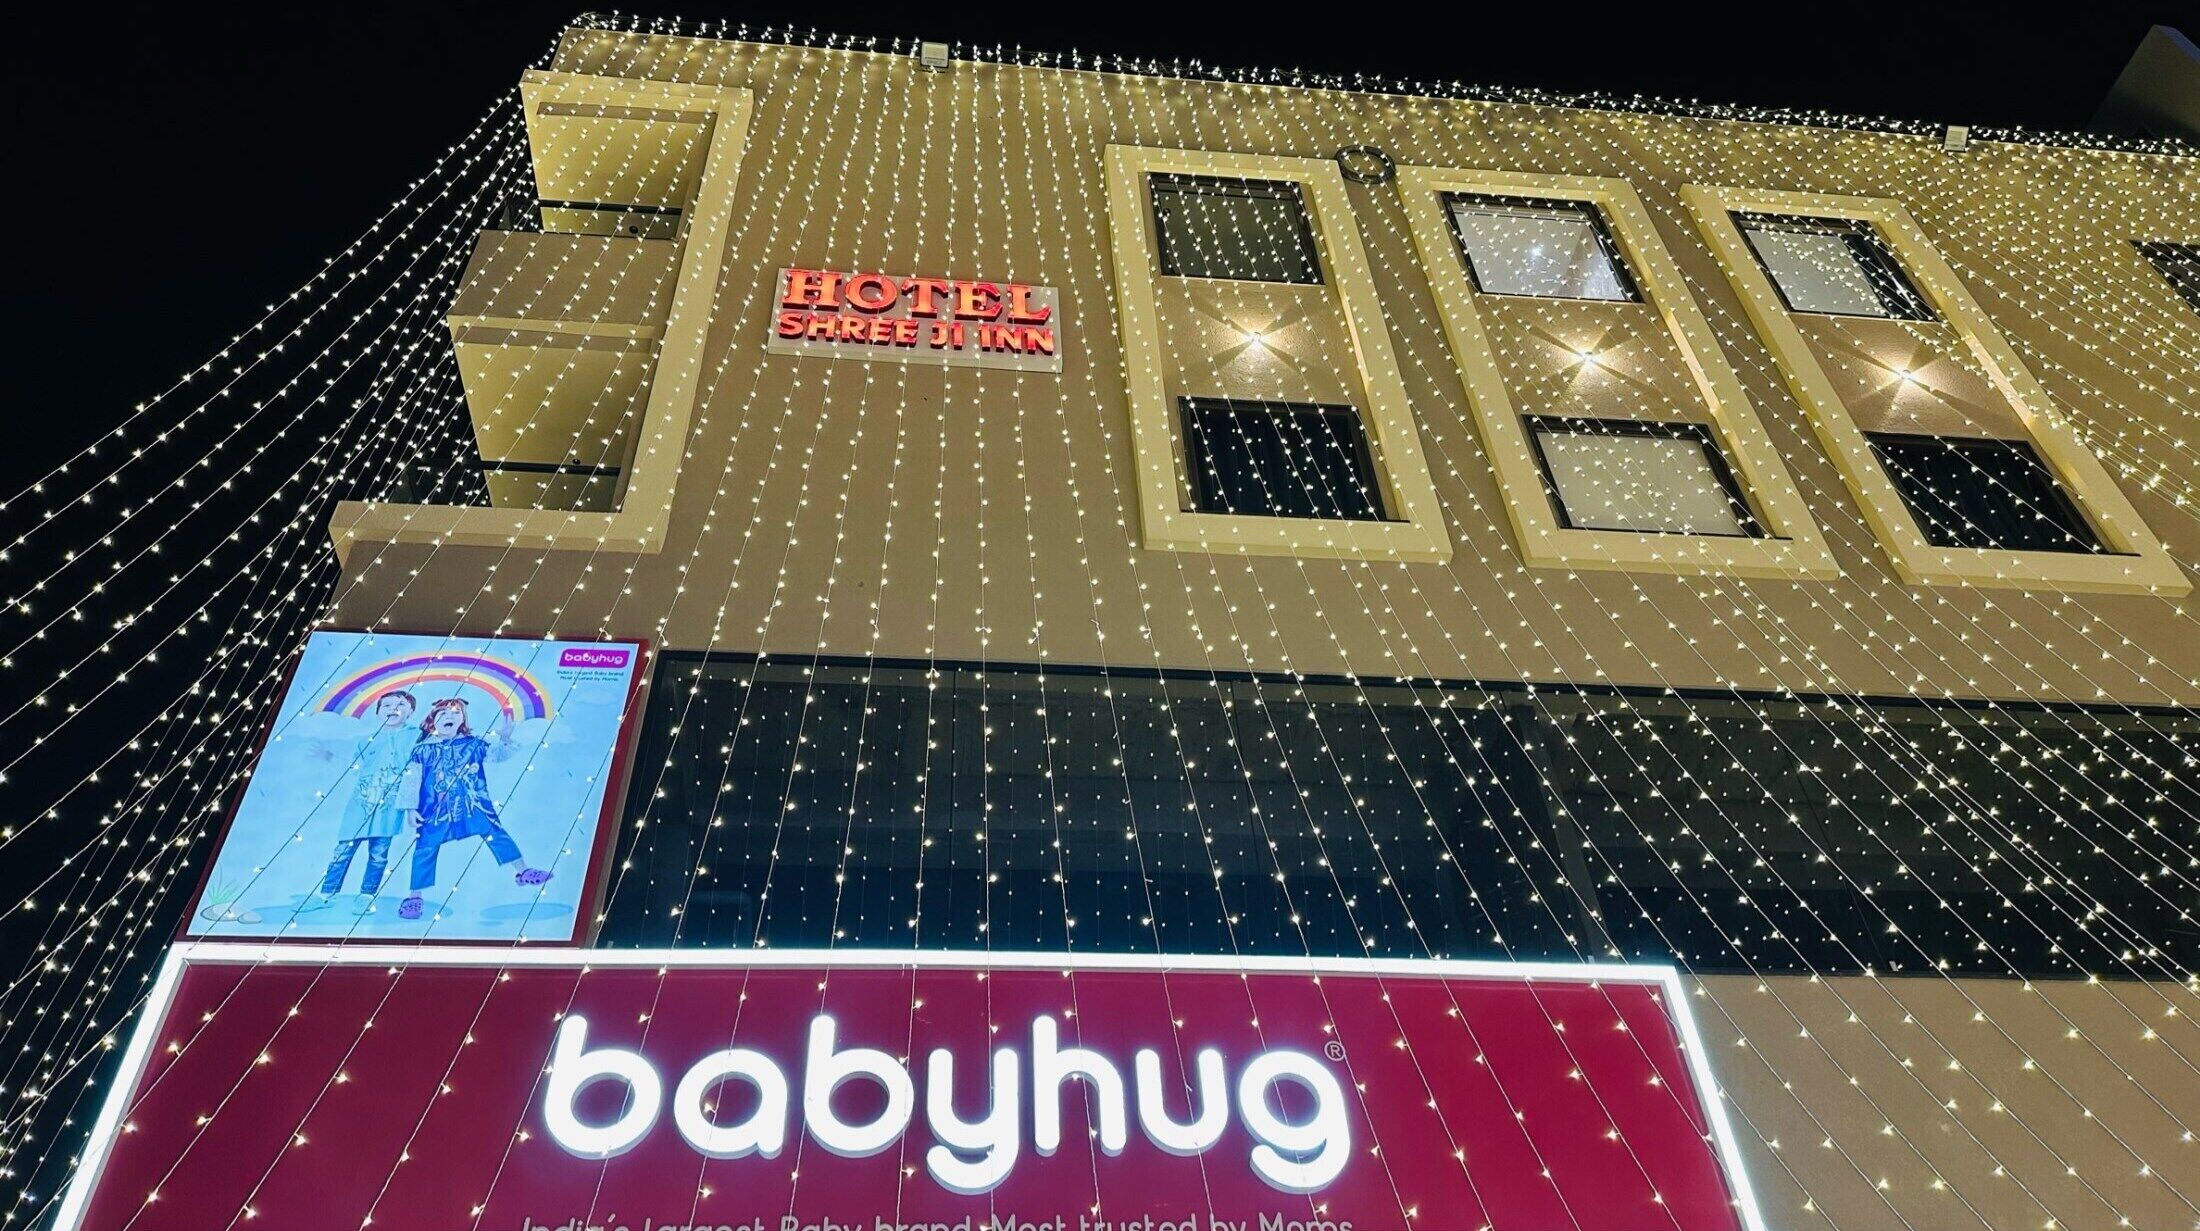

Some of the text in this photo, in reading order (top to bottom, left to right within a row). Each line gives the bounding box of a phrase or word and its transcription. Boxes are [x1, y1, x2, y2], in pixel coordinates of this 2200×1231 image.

[782, 269, 1052, 325] HOTEL
[778, 312, 1054, 356] SHREE JI INN
[564, 652, 624, 665] babyhug
[544, 1014, 1351, 1195] babyhug
